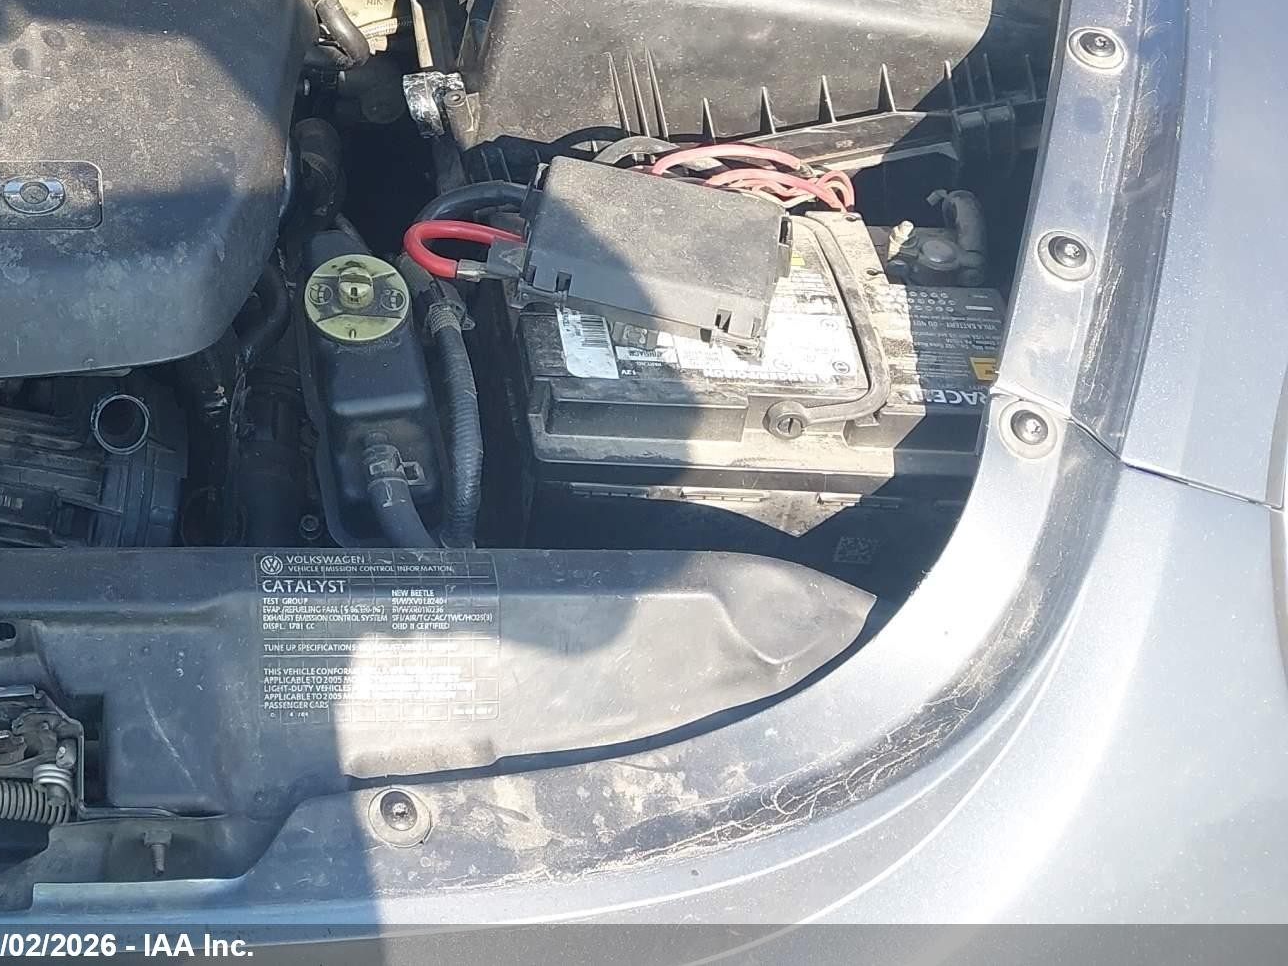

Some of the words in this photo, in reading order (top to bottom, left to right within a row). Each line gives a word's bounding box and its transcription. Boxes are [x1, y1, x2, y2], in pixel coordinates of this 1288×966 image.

[286, 555, 366, 564] VOLKSWAGEN
[287, 565, 319, 573] VEHICLE
[321, 565, 358, 573] EMISSION
[359, 565, 395, 573] CONTROL
[396, 565, 454, 573] INFORMATION
[261, 579, 347, 594] CATALYST
[391, 589, 409, 597] NEW
[410, 589, 435, 597] BEETLE
[262, 597, 281, 605] TEST
[282, 597, 309, 605] GROUP
[262, 614, 294, 622] EXHAUST
[295, 614, 327, 622] EMISSION
[328, 614, 360, 622] CONTROL
[360, 614, 388, 622] SYSTEM
[305, 622, 315, 630] CC
[416, 622, 450, 630] CERTIFIED
[263, 643, 284, 652] TUNE
[285, 643, 297, 652] UP
[263, 667, 281, 676] THIS
[283, 667, 316, 676] VEHICLE
[263, 676, 311, 685] APPLICABLE
[312, 676, 323, 685] TO
[324, 676, 342, 685] 2005
[263, 684, 314, 693] LIGHT-DUTY
[315, 684, 352, 693] VEHICLES
[263, 693, 311, 702] APPLICABLE
[312, 693, 323, 701] TO
[323, 693, 342, 701] 2005
[263, 701, 309, 709] PASSENGER
[310, 701, 329, 709] CARS
